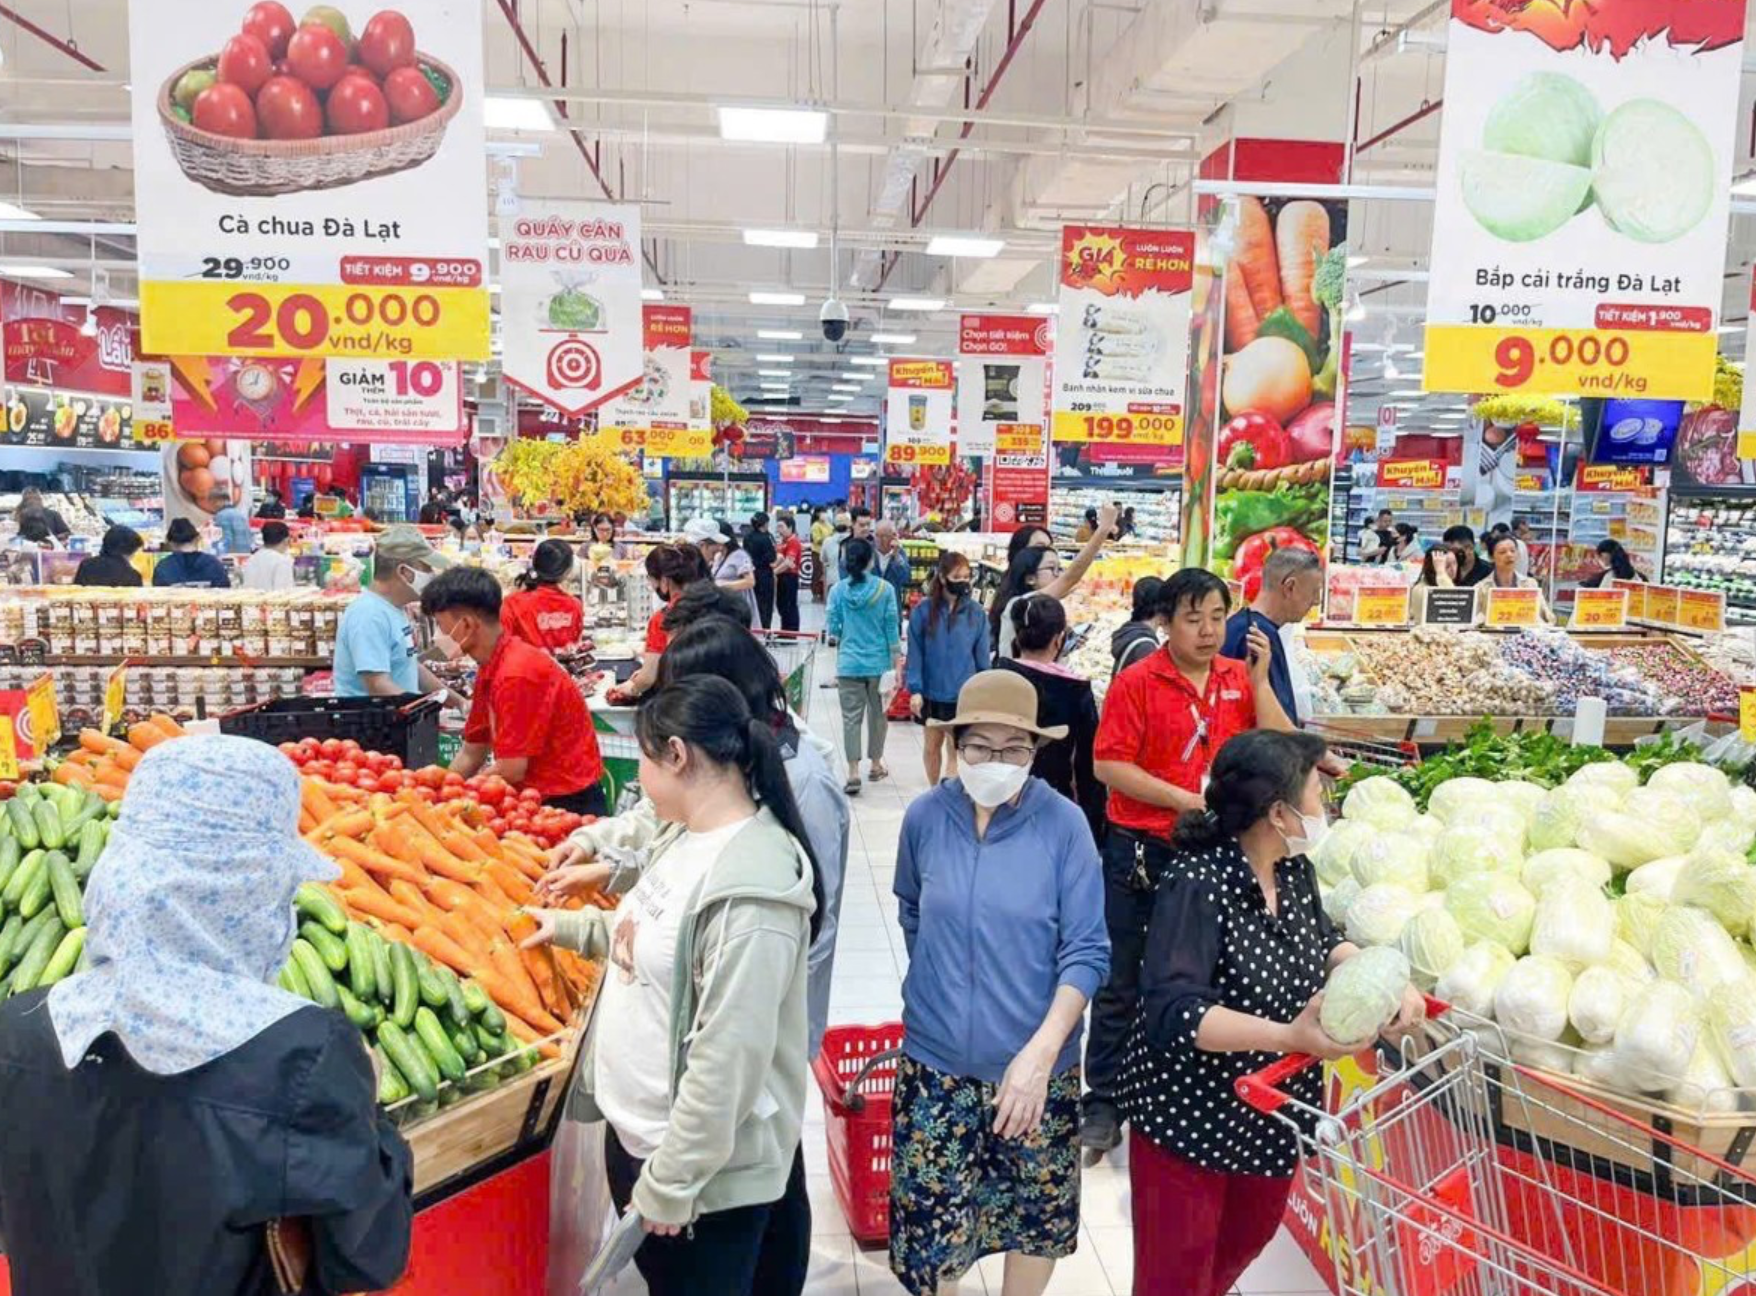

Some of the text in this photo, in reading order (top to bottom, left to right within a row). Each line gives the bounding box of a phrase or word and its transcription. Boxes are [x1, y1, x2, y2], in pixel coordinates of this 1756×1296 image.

[218, 214, 401, 242] Cà chua Đà Lạt
[508, 244, 550, 261] RAU
[555, 240, 582, 261] CỦ
[1475, 265, 1682, 294] Bắp cải trắng Đà Lạt
[225, 292, 441, 350] 20.000
[328, 331, 413, 355] vnd/kg
[1493, 334, 1630, 389] 9.000
[339, 367, 385, 386] GIẢM
[1578, 373, 1648, 392] vnd/kg
